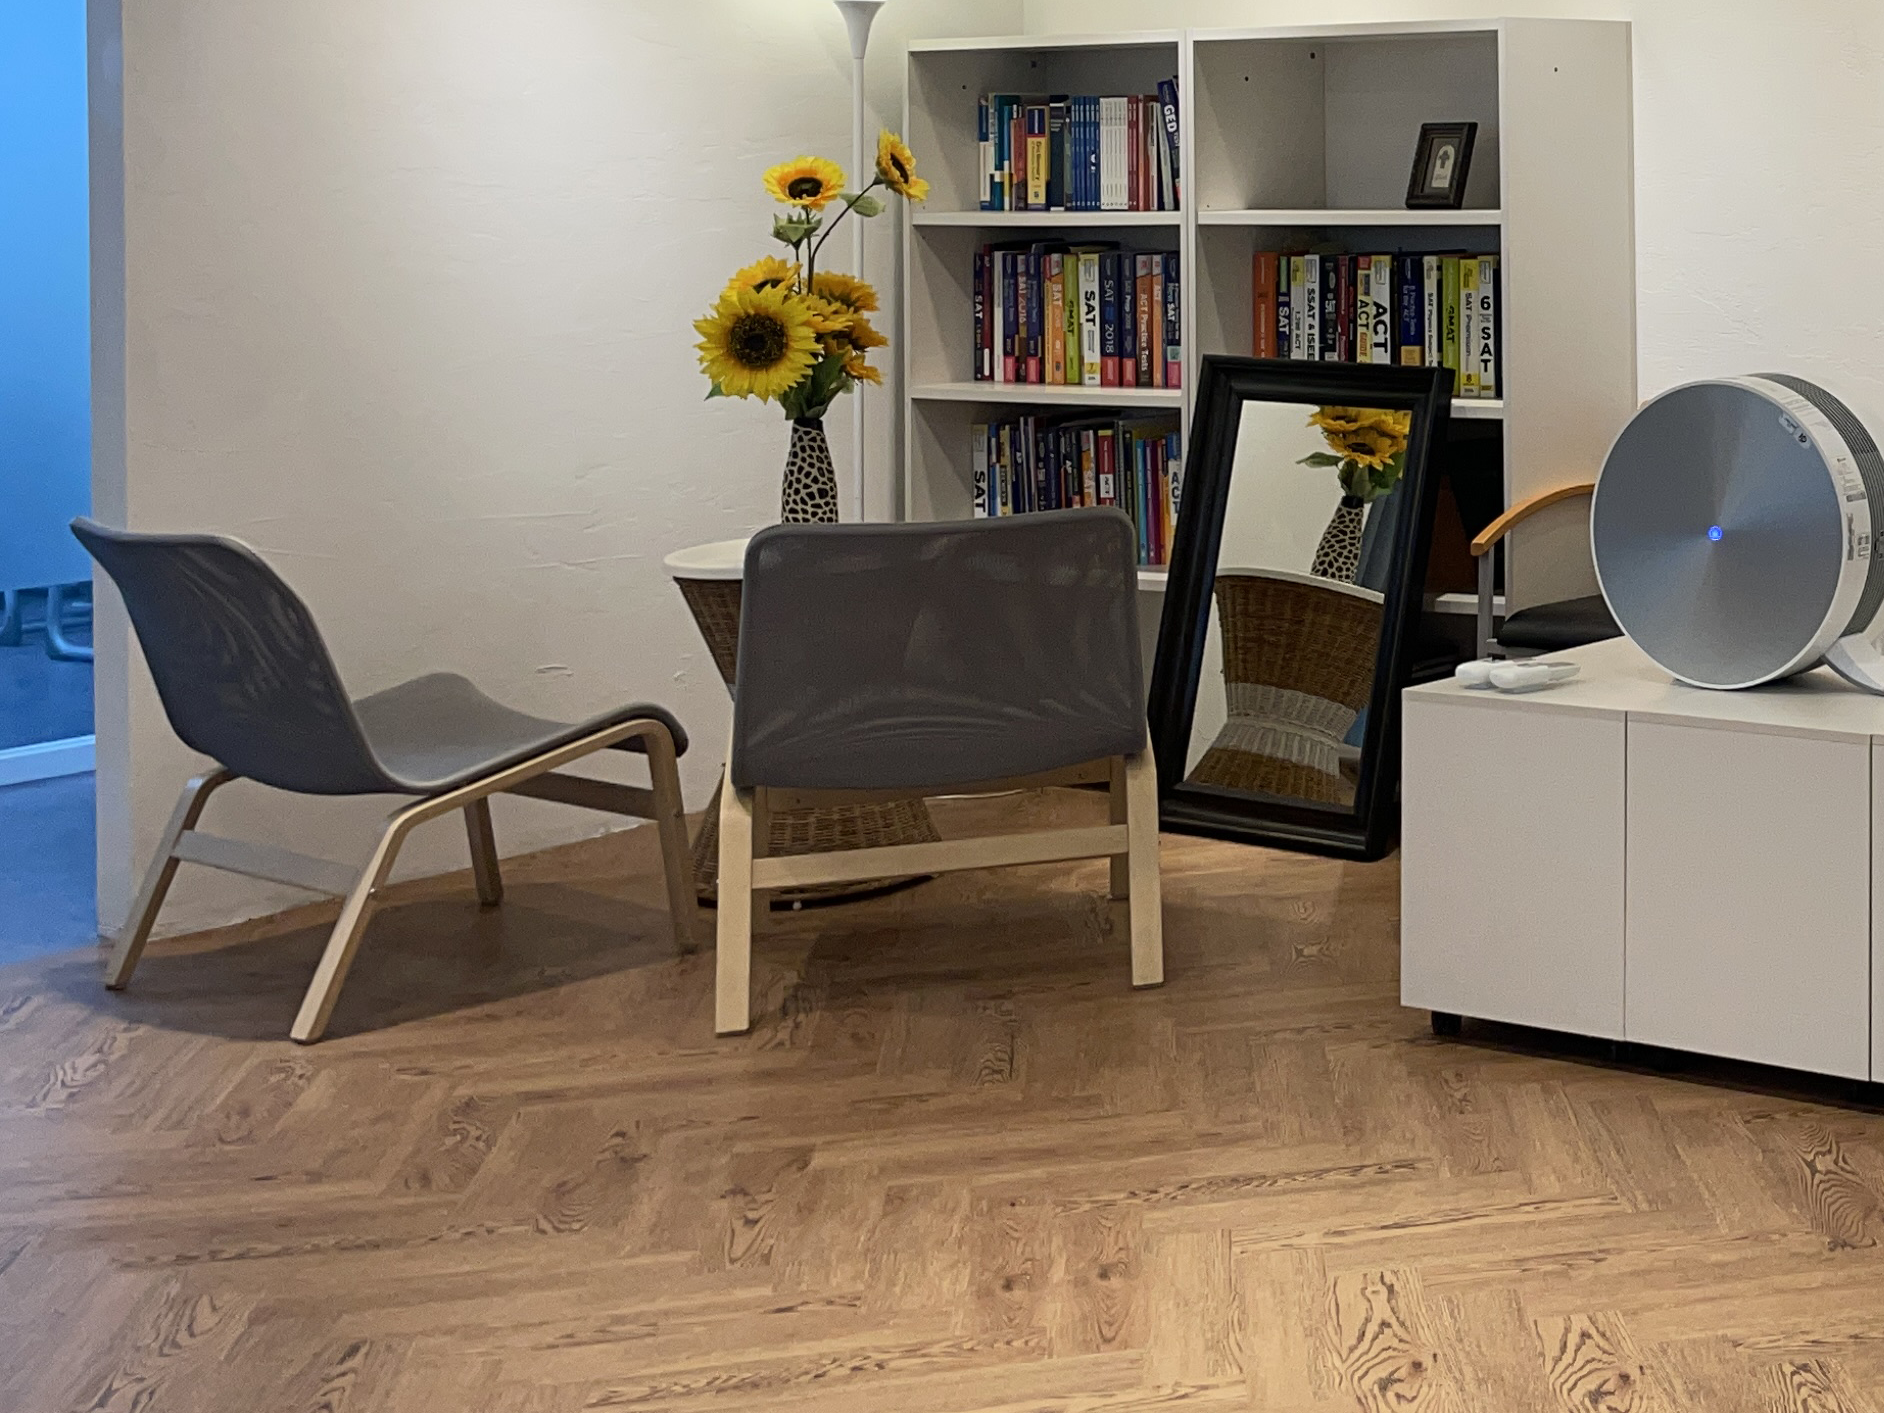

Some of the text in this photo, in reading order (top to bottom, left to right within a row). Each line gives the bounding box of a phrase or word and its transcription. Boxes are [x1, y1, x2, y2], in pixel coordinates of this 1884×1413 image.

[1163, 104, 1178, 133] GED
[1018, 275, 1027, 294] SAT
[1052, 283, 1063, 307] SAT
[1103, 280, 1114, 304] SAT
[974, 294, 983, 320] SAT
[1084, 290, 1096, 327] SAT
[1167, 302, 1176, 321] SAT
[1306, 287, 1316, 320] SSAT
[1358, 299, 1370, 331] ACT
[1465, 292, 1473, 312] SAT
[1480, 295, 1492, 311] 6
[1140, 293, 1149, 372] ACT Practice Tests
[1278, 306, 1290, 335] SAT
[1372, 300, 1389, 354] ACT
[1104, 323, 1114, 354] 2018
[1294, 332, 1302, 350] ACT
[1306, 333, 1316, 361] ISEE
[1479, 326, 1493, 373] SAT
[974, 470, 986, 513] SAT
